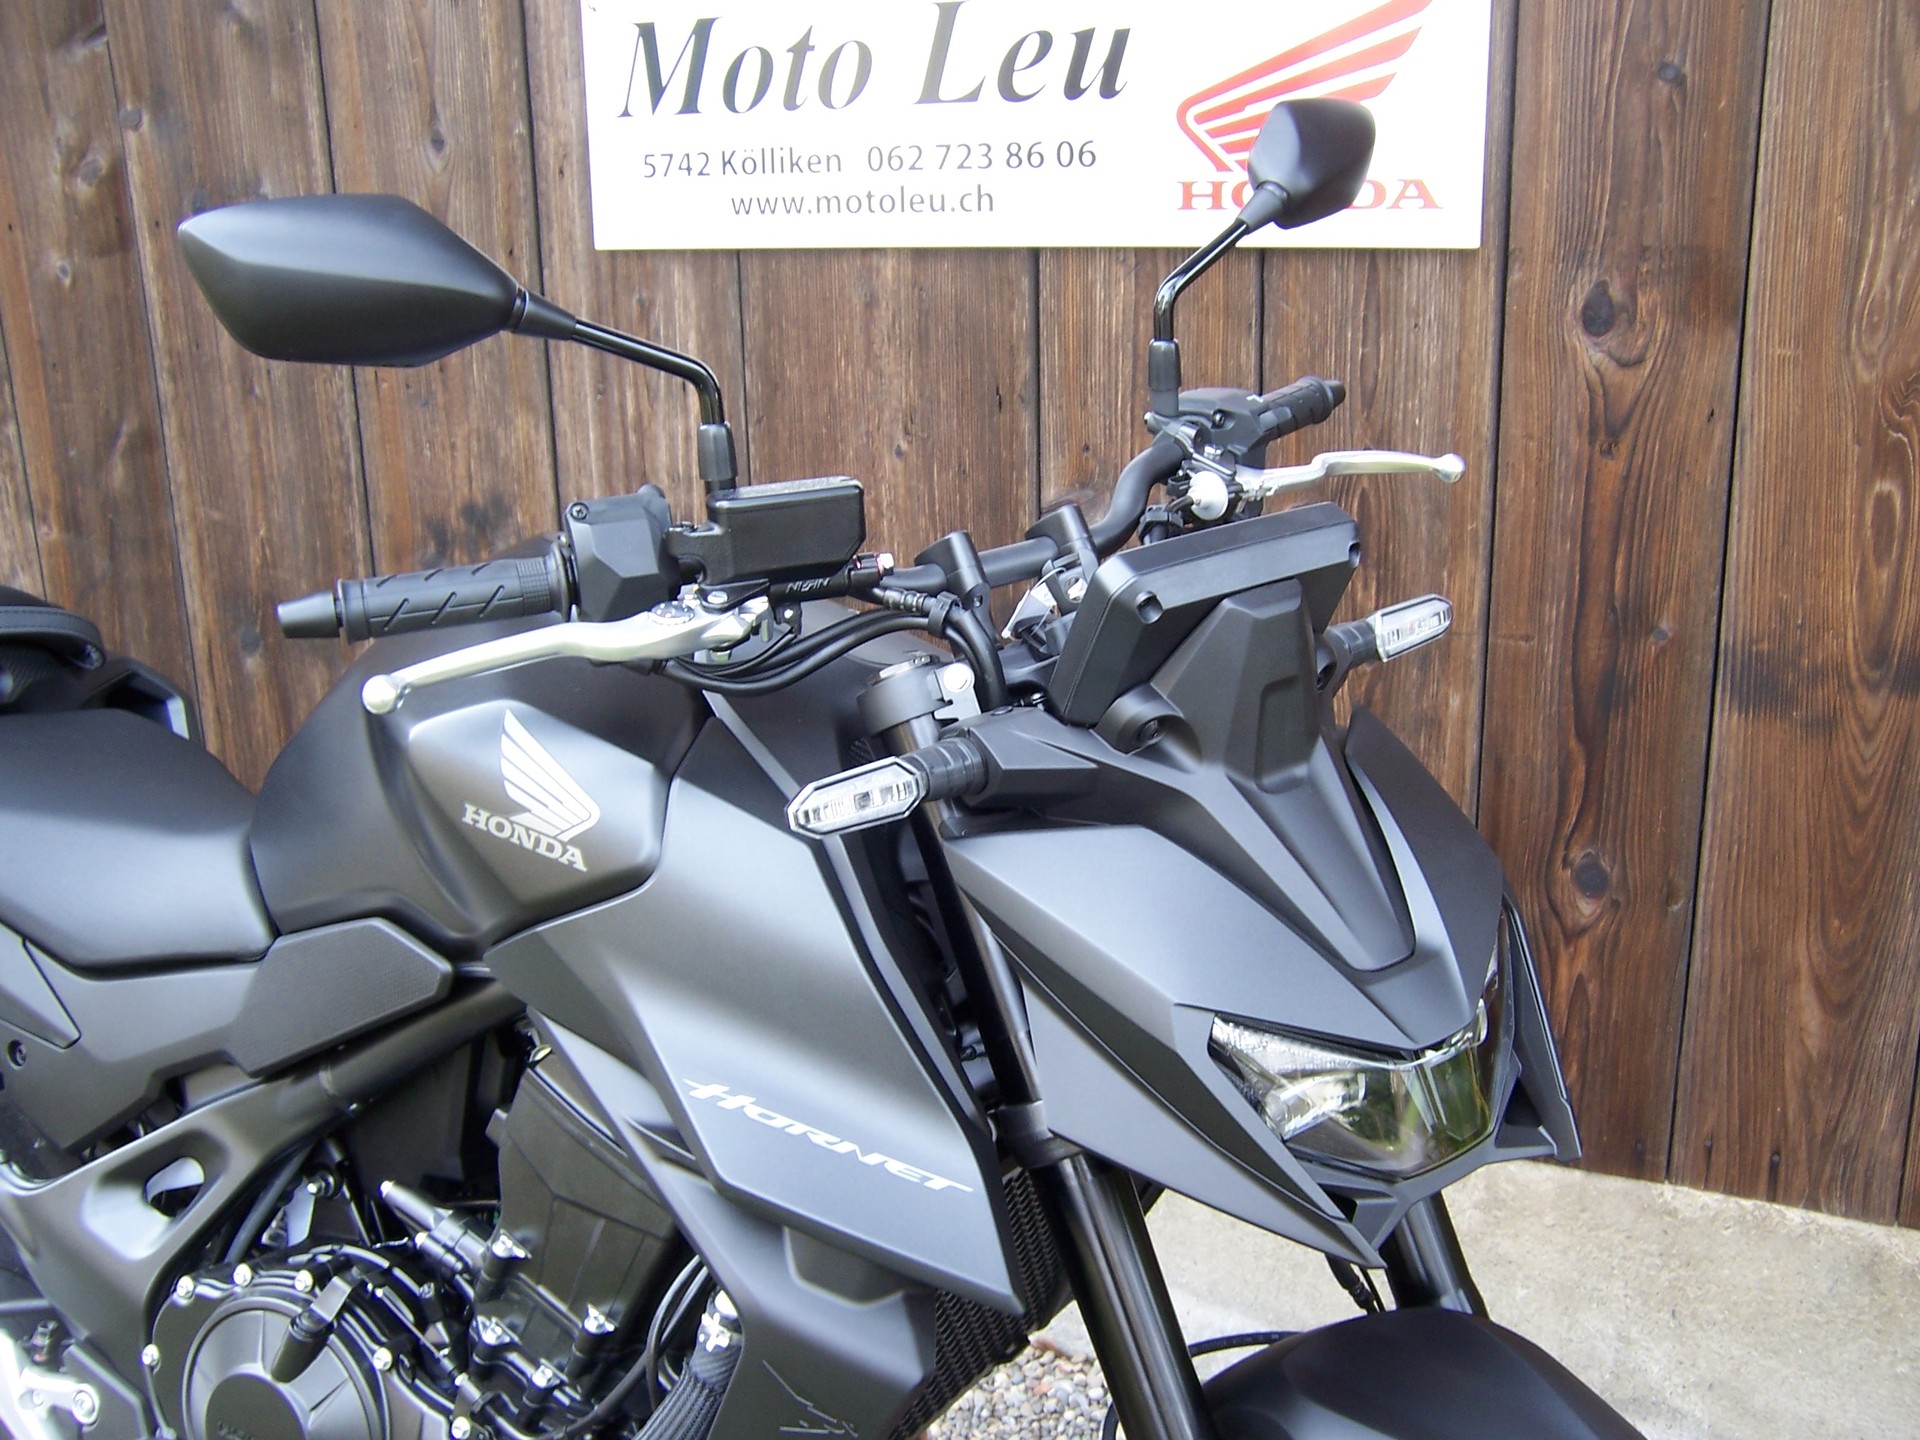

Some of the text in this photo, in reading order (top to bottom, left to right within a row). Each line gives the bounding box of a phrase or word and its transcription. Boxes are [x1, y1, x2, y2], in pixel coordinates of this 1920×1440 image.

[617, 0, 1131, 118] Moto Leu
[643, 140, 1097, 178] 5742 Kölliken 062 723 86 06
[730, 183, 994, 216] www.motoleu.ch
[1177, 179, 1444, 210] HDA
[461, 803, 588, 872] HONDA
